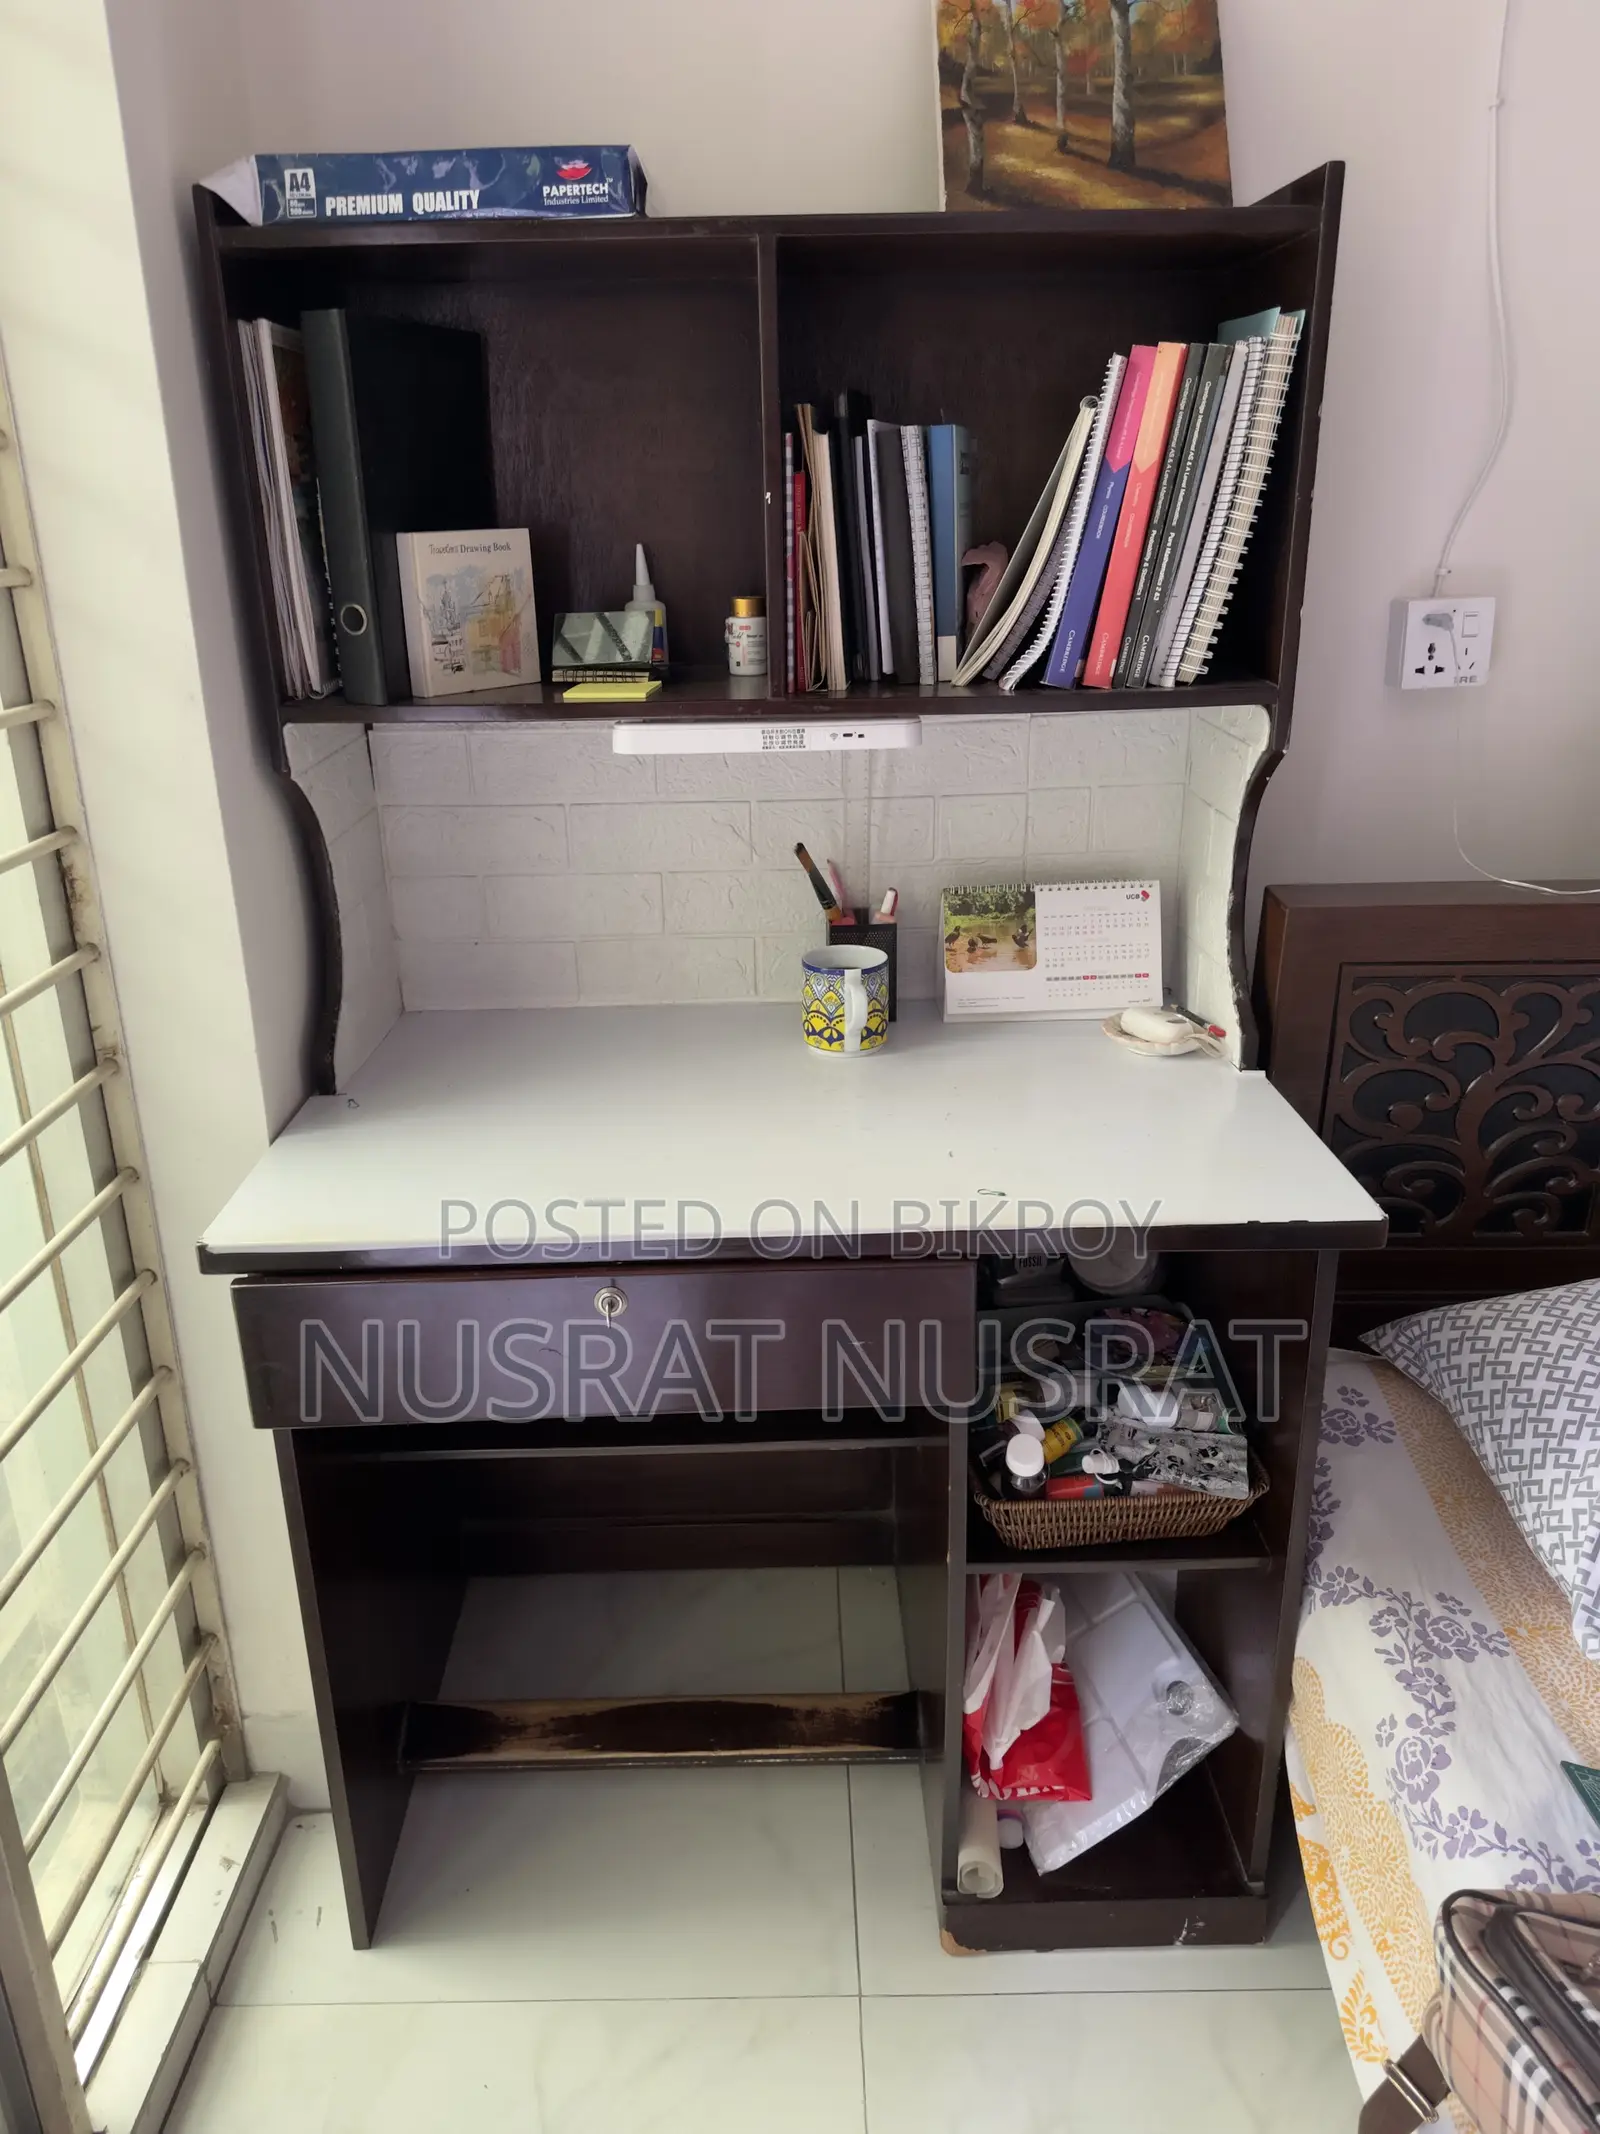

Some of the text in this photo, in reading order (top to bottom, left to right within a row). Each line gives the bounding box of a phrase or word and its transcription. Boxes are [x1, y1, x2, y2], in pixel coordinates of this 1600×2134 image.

[290, 172, 311, 192] A4
[542, 183, 608, 197] PAPERTECH
[325, 193, 403, 216] PREMIUM
[412, 189, 479, 214] QUALITY
[544, 195, 608, 206] Industries Limited
[1180, 378, 1191, 410] Cambridge
[1199, 381, 1211, 413] Cambridge
[1172, 411, 1183, 447] International
[1191, 415, 1202, 450] International
[1188, 451, 1194, 461] AS
[460, 543, 492, 554] Drawing
[493, 541, 511, 552] Book
[1145, 530, 1156, 561] Probability
[1137, 568, 1147, 595] Statistics
[1158, 548, 1171, 585] Mathematics
[1060, 630, 1075, 673] CAMBRIDGE
[1134, 635, 1149, 678] CAMBRIDGE
